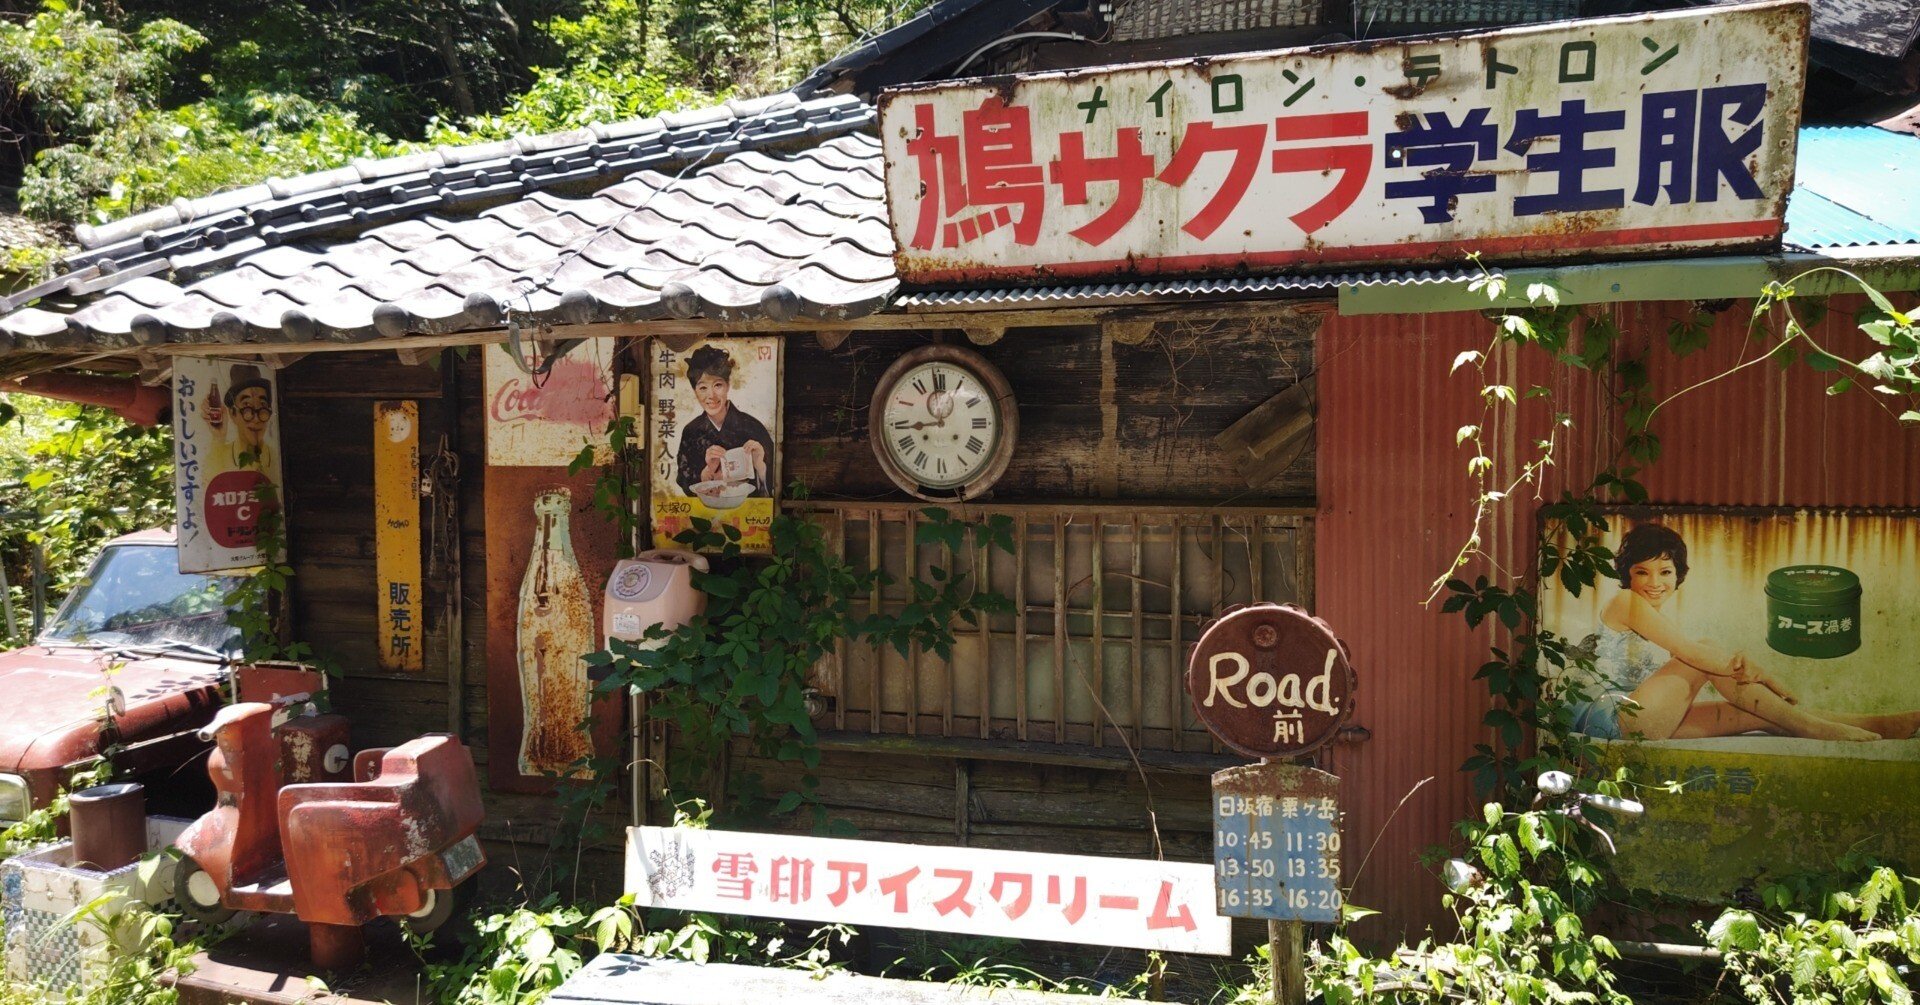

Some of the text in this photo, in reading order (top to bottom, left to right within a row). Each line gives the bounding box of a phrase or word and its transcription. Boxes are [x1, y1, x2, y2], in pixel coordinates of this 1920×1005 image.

[1077, 36, 1680, 124] ナイロン・テトロン
[907, 82, 1768, 250] 鳩サクラ学生服
[178, 375, 200, 547] おいしいですよ!
[237, 506, 251, 521] C
[657, 502, 691, 514] 大塚の
[388, 582, 412, 657] 販売所
[1778, 614, 1853, 635] アース渦巻
[1273, 709, 1304, 744] 前
[1218, 830, 1341, 852] 10:45 11:30
[1219, 857, 1341, 879] 13:50 13:35
[712, 850, 1198, 934] 雪印アイスクリーム
[1219, 887, 1343, 910] 16:35 16:20
